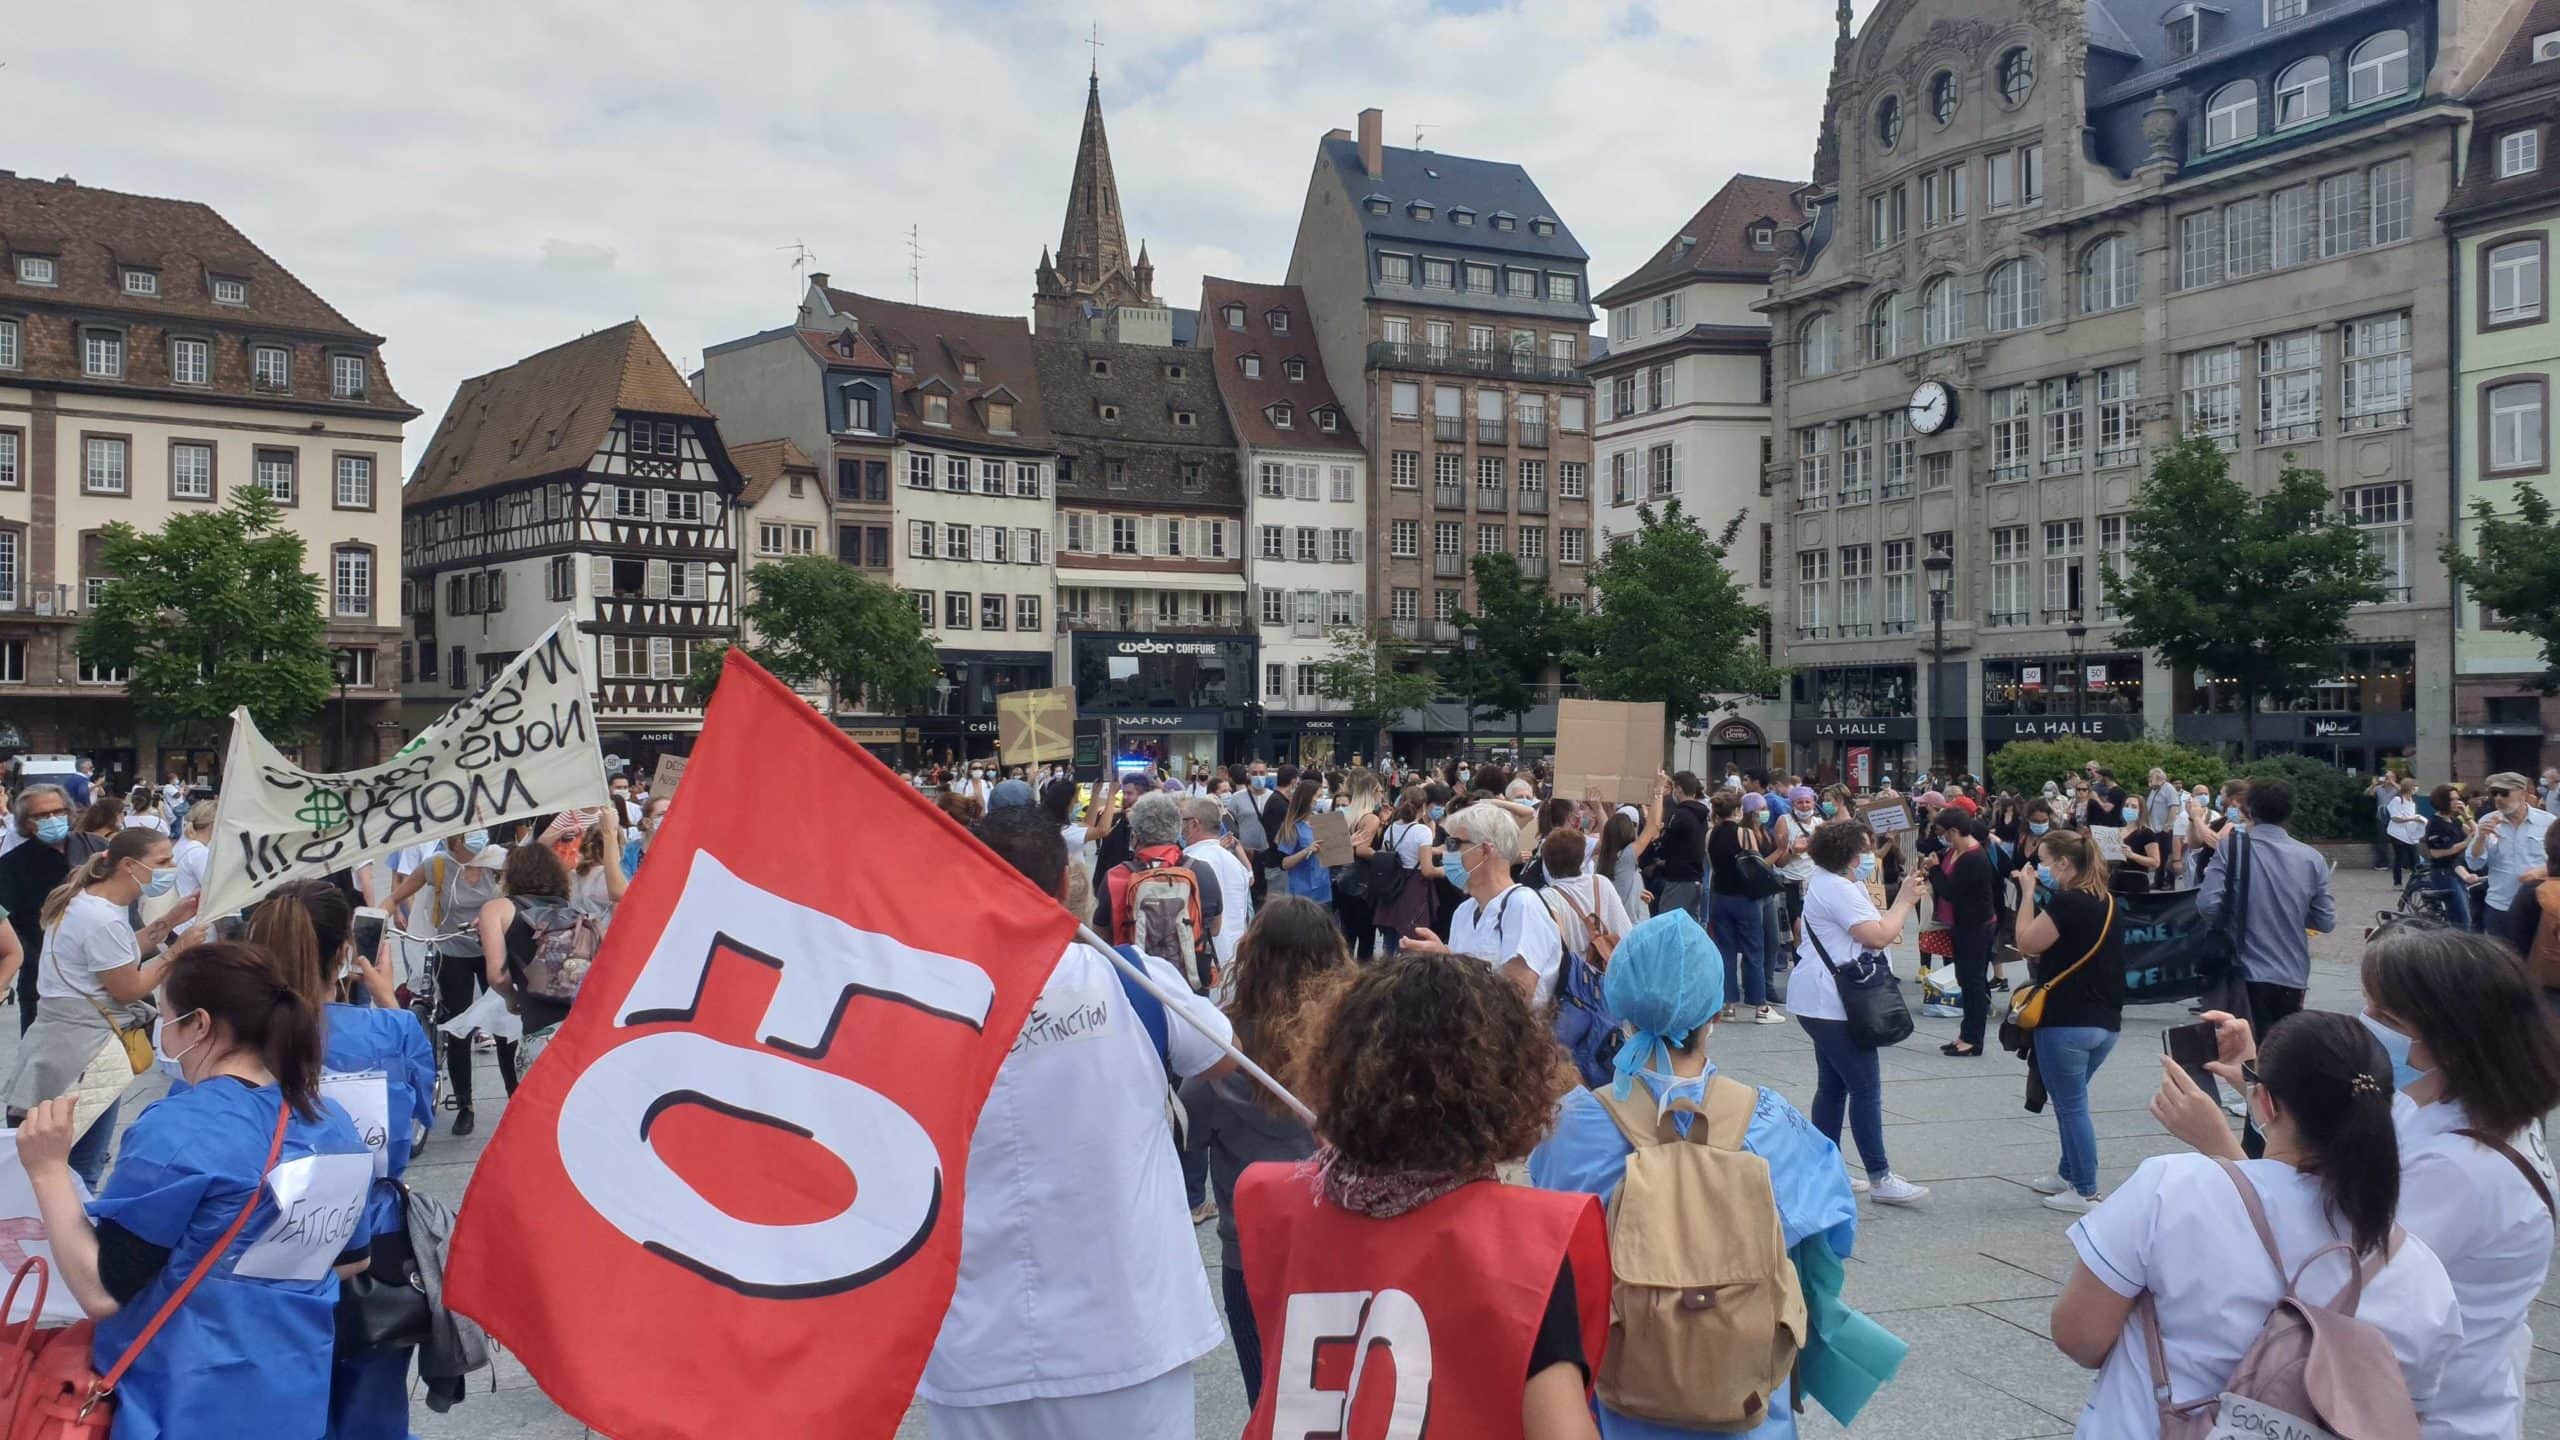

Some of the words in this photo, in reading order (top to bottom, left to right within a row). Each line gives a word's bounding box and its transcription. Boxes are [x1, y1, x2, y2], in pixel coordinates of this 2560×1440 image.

[1118, 638, 1173, 653] weber
[1175, 643, 1217, 654] COIFFURE
[969, 721, 1000, 732] celi
[1118, 717, 1149, 725] NAF
[1152, 717, 1184, 725] NAF
[1816, 723, 1833, 734] LA
[1839, 723, 1887, 734] HALLE
[2015, 722, 2036, 733] LA
[641, 732, 674, 740] ANDRÉ
[1272, 1288, 1433, 1440] FO
